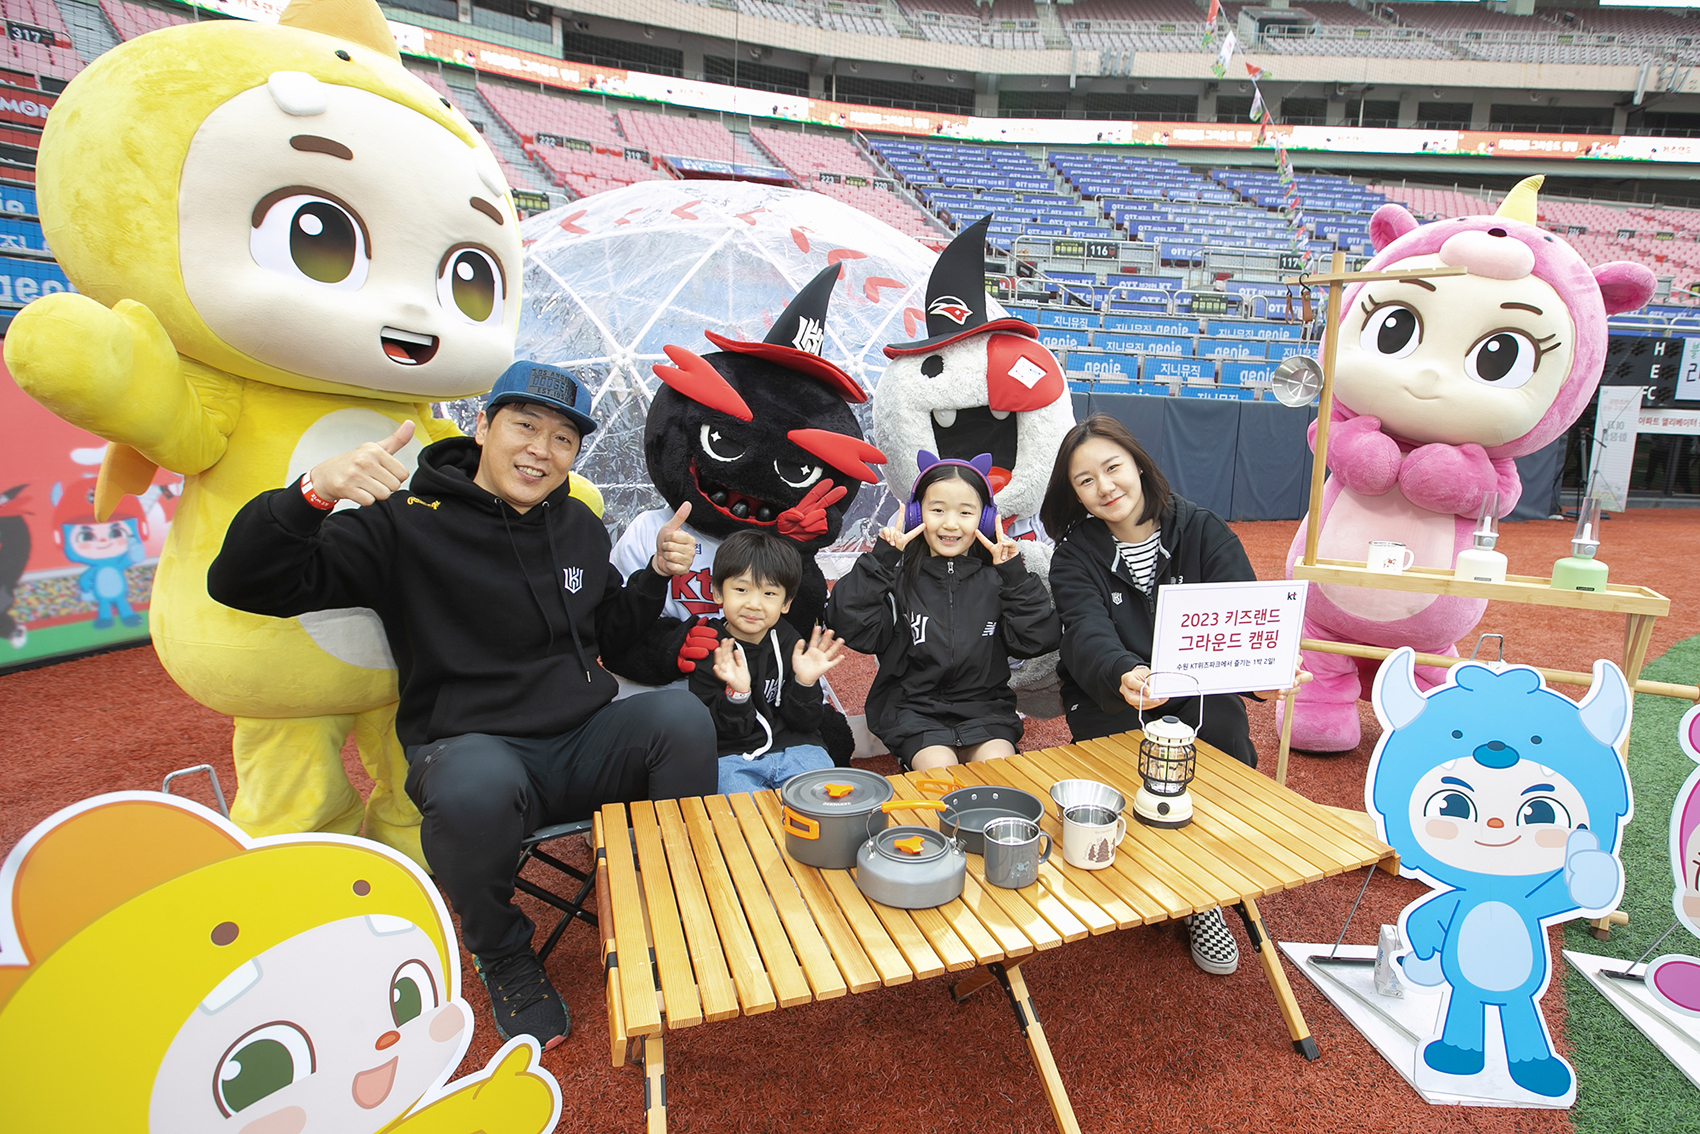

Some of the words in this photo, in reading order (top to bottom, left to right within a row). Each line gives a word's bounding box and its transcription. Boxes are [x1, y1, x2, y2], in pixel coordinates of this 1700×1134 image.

[11, 26, 41, 44] 317
[539, 135, 556, 147] 222
[626, 150, 641, 160] 319
[820, 174, 834, 184] 223
[874, 181, 888, 190] 320
[1090, 245, 1108, 256] 116
[1171, 248, 1186, 256] OTT
[1281, 256, 1298, 267] 117
[1269, 304, 1286, 313] OTT
[1054, 315, 1088, 329] 지니뮤직
[1156, 323, 1189, 335] genie
[1258, 328, 1290, 339] genie
[1043, 335, 1077, 348] genie
[1148, 341, 1182, 353] genie
[1215, 345, 1250, 358] genie
[1654, 342, 1666, 356] H
[1085, 359, 1121, 374] genie
[1160, 363, 1200, 377] 지니뮤직
[1650, 364, 1660, 378] E
[1638, 417, 1659, 425] 아파트
[1287, 592, 1297, 600] kt
[1181, 612, 1219, 628] 2023
[1225, 608, 1280, 626] 키즈랜드
[1178, 633, 1242, 652] 그라운드
[1248, 630, 1279, 650] 캠핑
[1190, 660, 1233, 669] KT위즈파크에서
[1234, 659, 1251, 668] 즐기는
[1253, 658, 1262, 666] 1박
